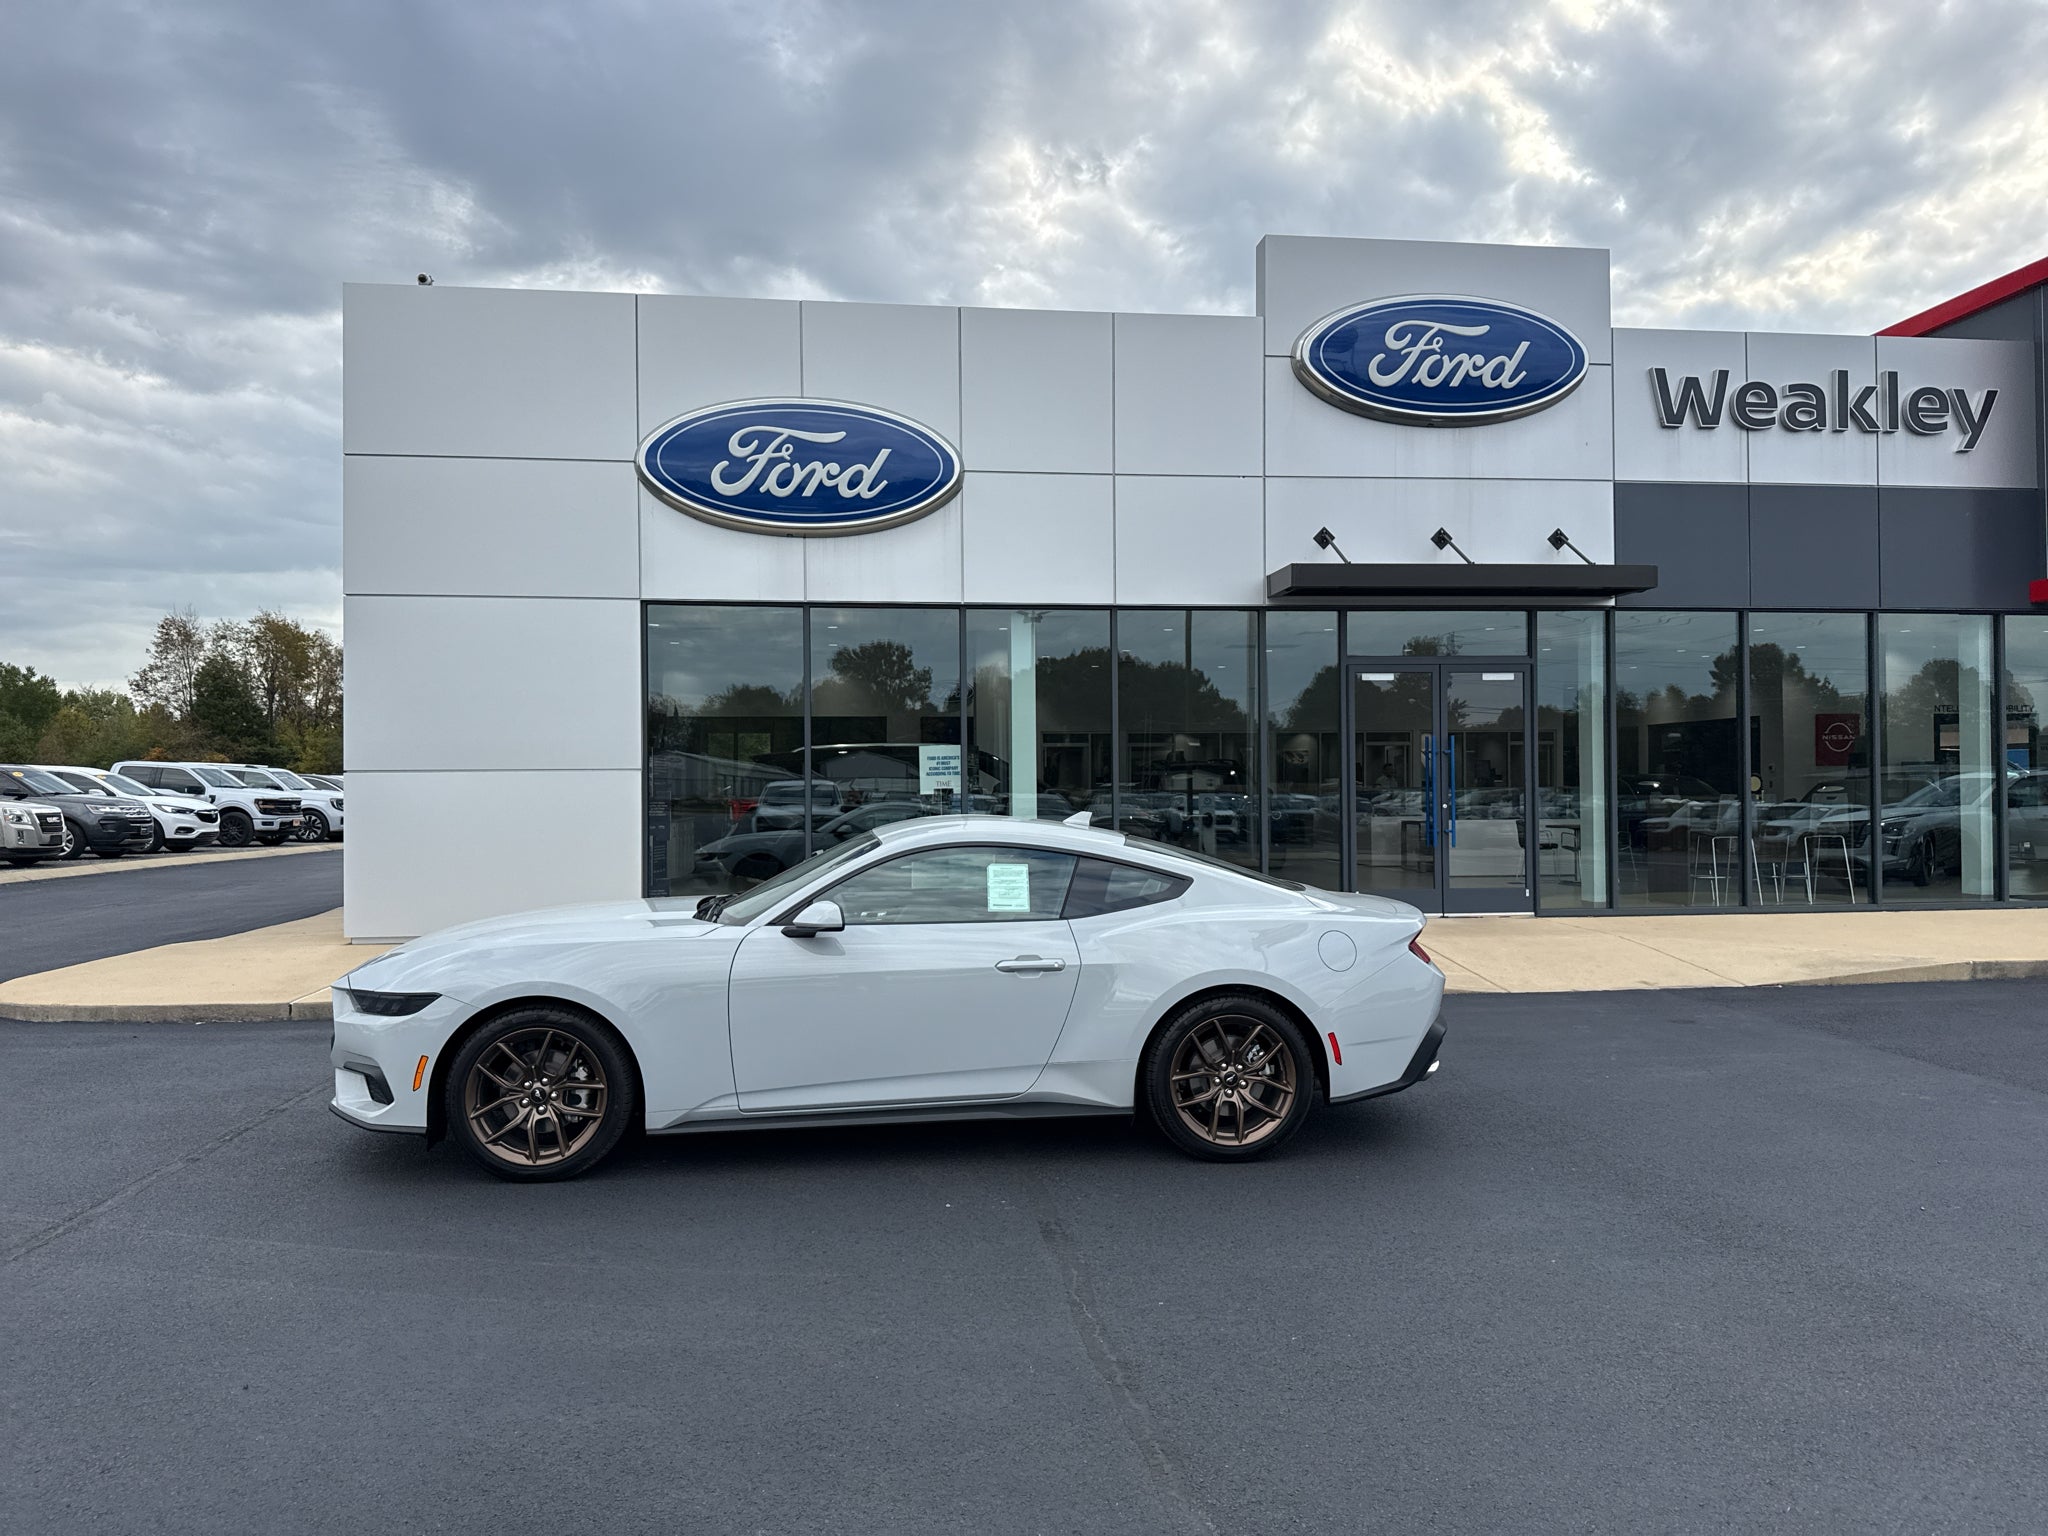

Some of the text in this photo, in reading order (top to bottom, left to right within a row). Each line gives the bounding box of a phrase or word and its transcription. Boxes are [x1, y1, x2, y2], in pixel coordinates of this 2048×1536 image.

[1368, 320, 1531, 389] Ford
[1647, 366, 1999, 453] Weakley
[710, 425, 892, 499] Ford
